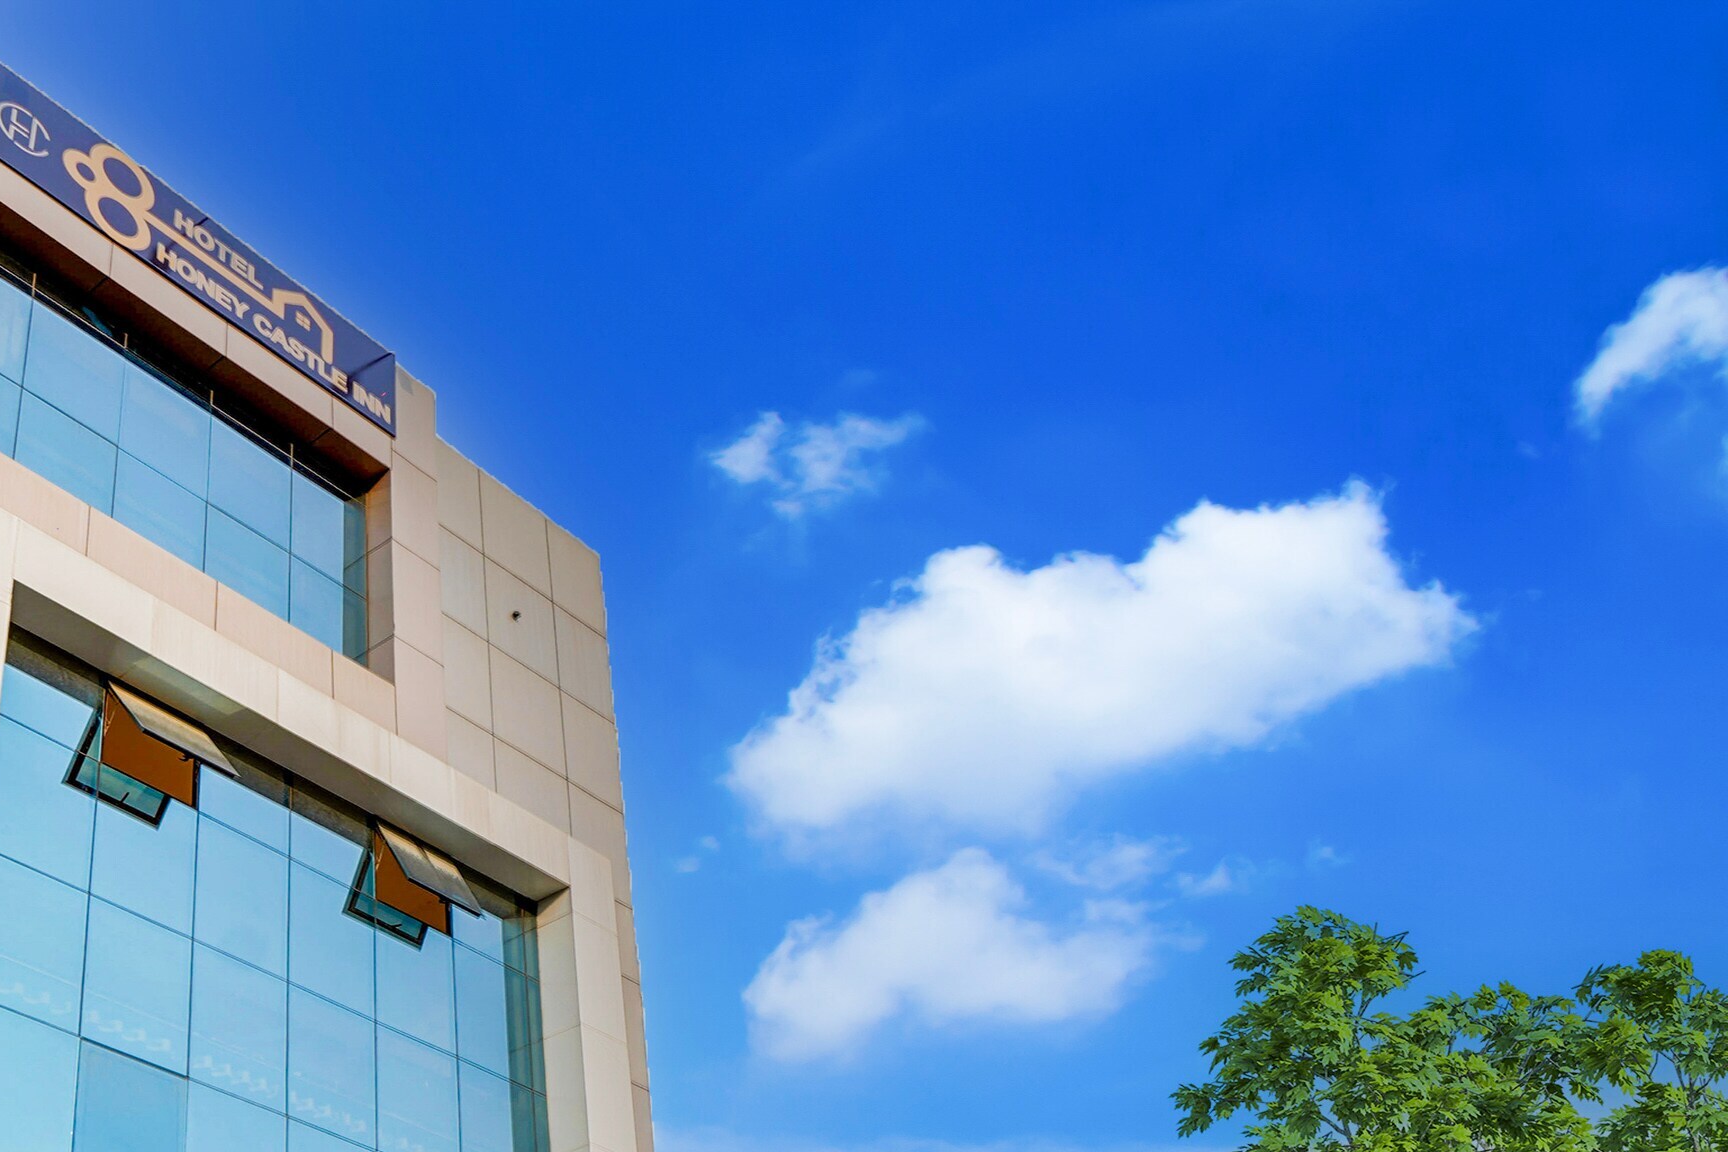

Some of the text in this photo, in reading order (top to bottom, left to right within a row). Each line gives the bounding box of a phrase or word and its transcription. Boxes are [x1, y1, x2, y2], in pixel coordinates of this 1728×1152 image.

[174, 208, 264, 290] HOTEL
[156, 241, 391, 425] HONEY CASTLE INN
